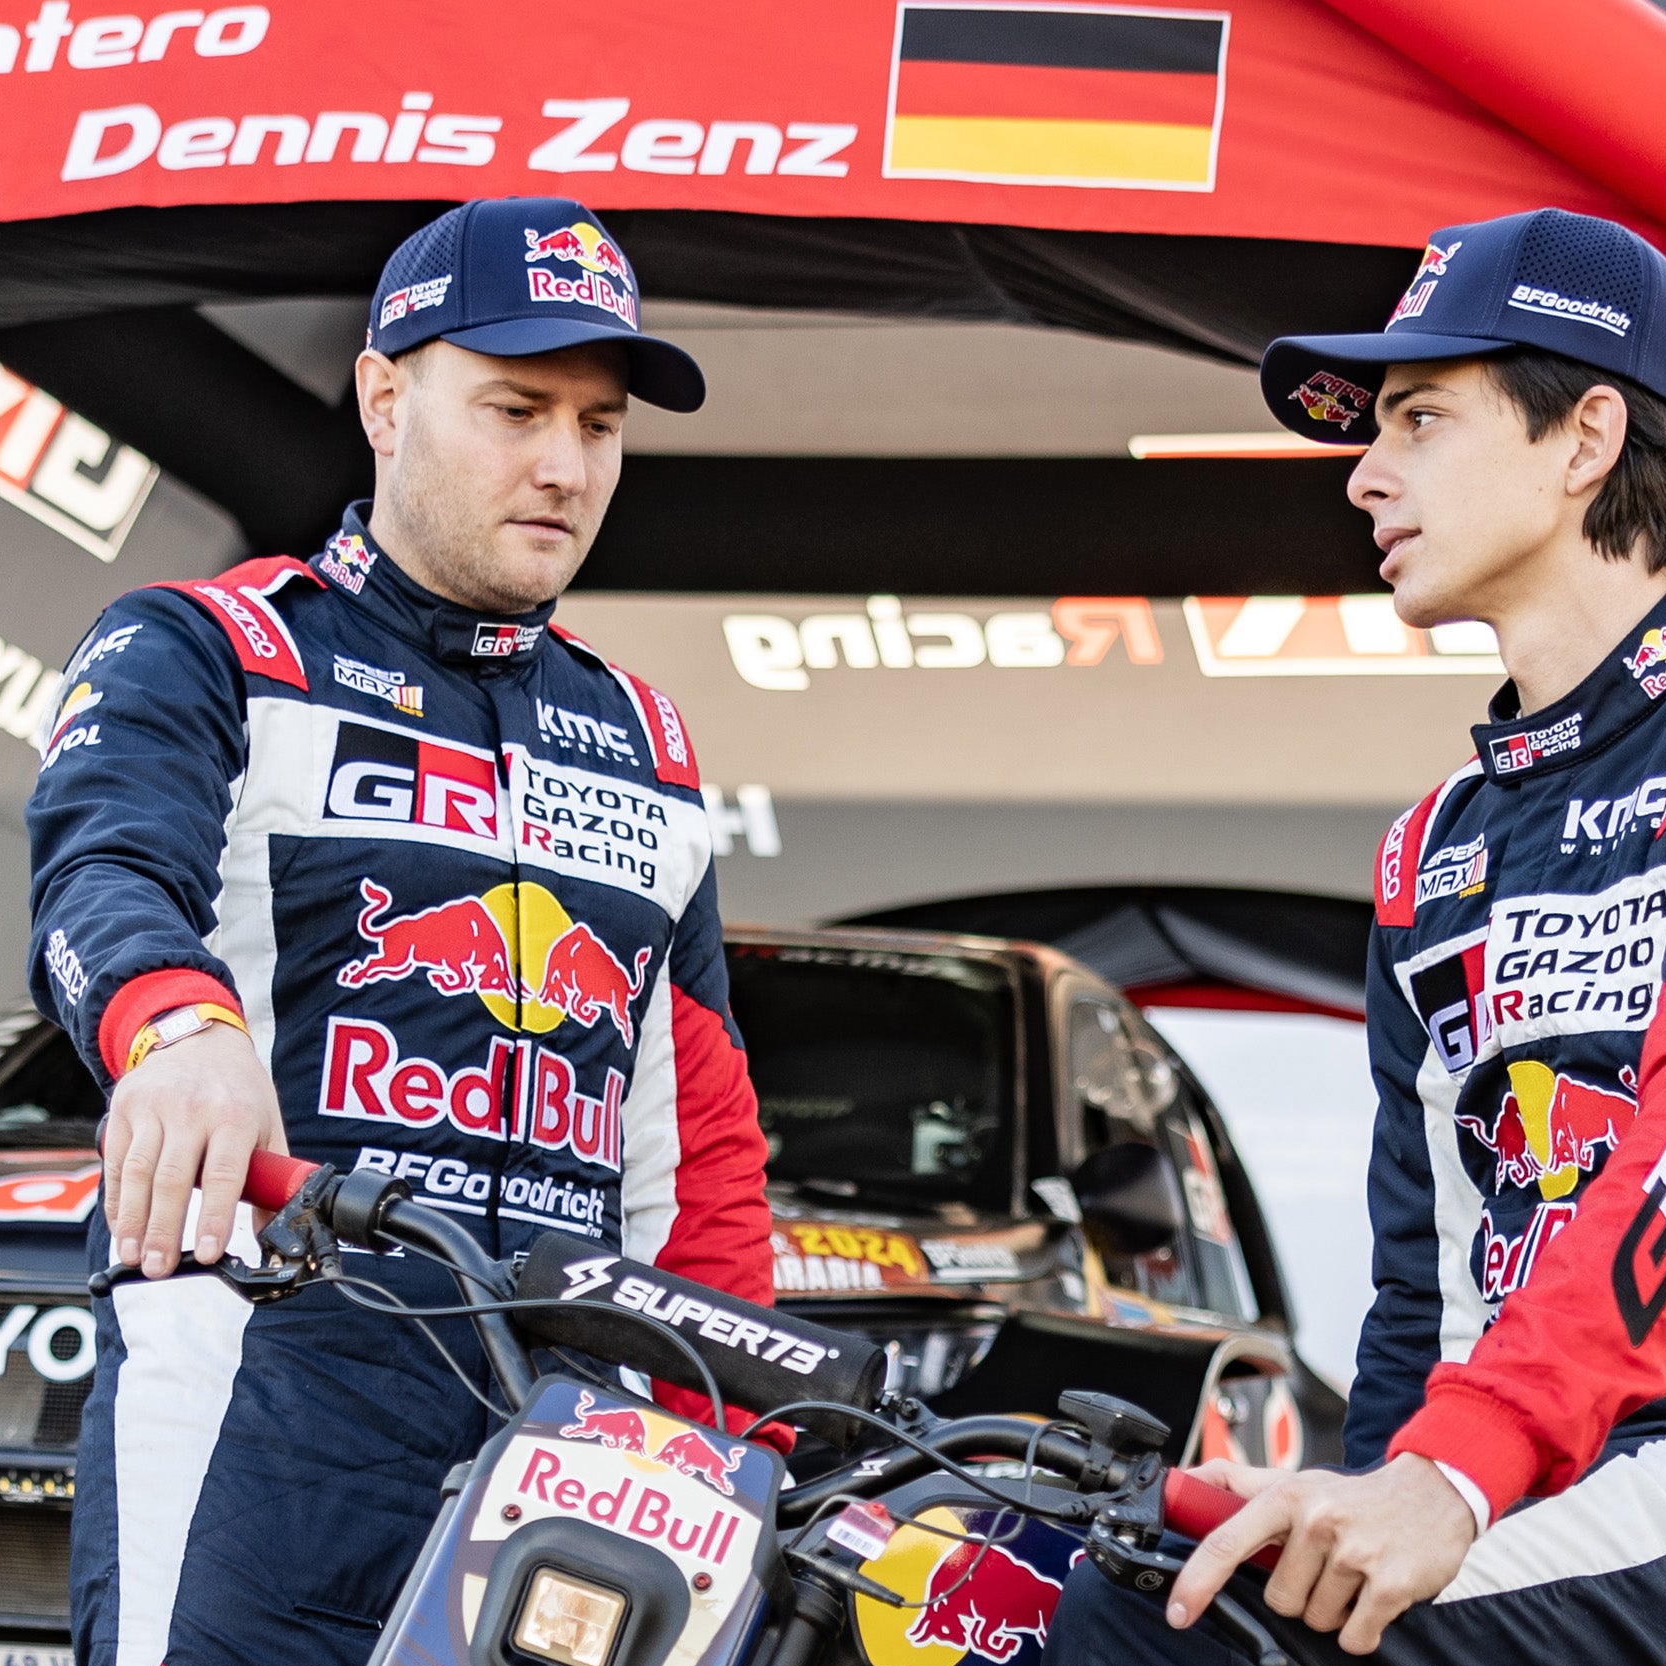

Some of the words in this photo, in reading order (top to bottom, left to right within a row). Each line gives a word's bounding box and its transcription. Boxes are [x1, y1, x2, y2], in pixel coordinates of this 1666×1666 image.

[61, 91, 503, 182] Dennis
[529, 97, 859, 178] Zenz
[530, 269, 596, 303] Red
[596, 272, 638, 331] Bull
[1512, 284, 1631, 331] BFGoodrich
[475, 636, 514, 654] GR
[337, 667, 397, 700] MAX
[1496, 748, 1532, 771] GR
[1527, 712, 1582, 741] TOYOTA
[1529, 726, 1580, 752] GAZOO
[1532, 735, 1582, 759] Racing
[329, 762, 497, 841] GR
[523, 760, 667, 826] TOYOTA
[523, 793, 658, 851] GAZOO
[521, 821, 656, 889] Racing
[1419, 860, 1475, 899] MAX
[1424, 833, 1484, 870] SPEED
[1495, 935, 1654, 986] GAZOO
[1492, 981, 1654, 1024] Racing
[325, 1022, 526, 1140] Red
[535, 1056, 624, 1167] Bull
[353, 1147, 605, 1224] BFGoodrich
[772, 1255, 885, 1291] RABIA
[791, 1225, 919, 1279] 2024
[613, 1275, 825, 1376] SUPER73
[517, 1449, 631, 1520] Red
[626, 1483, 741, 1568] Bull
